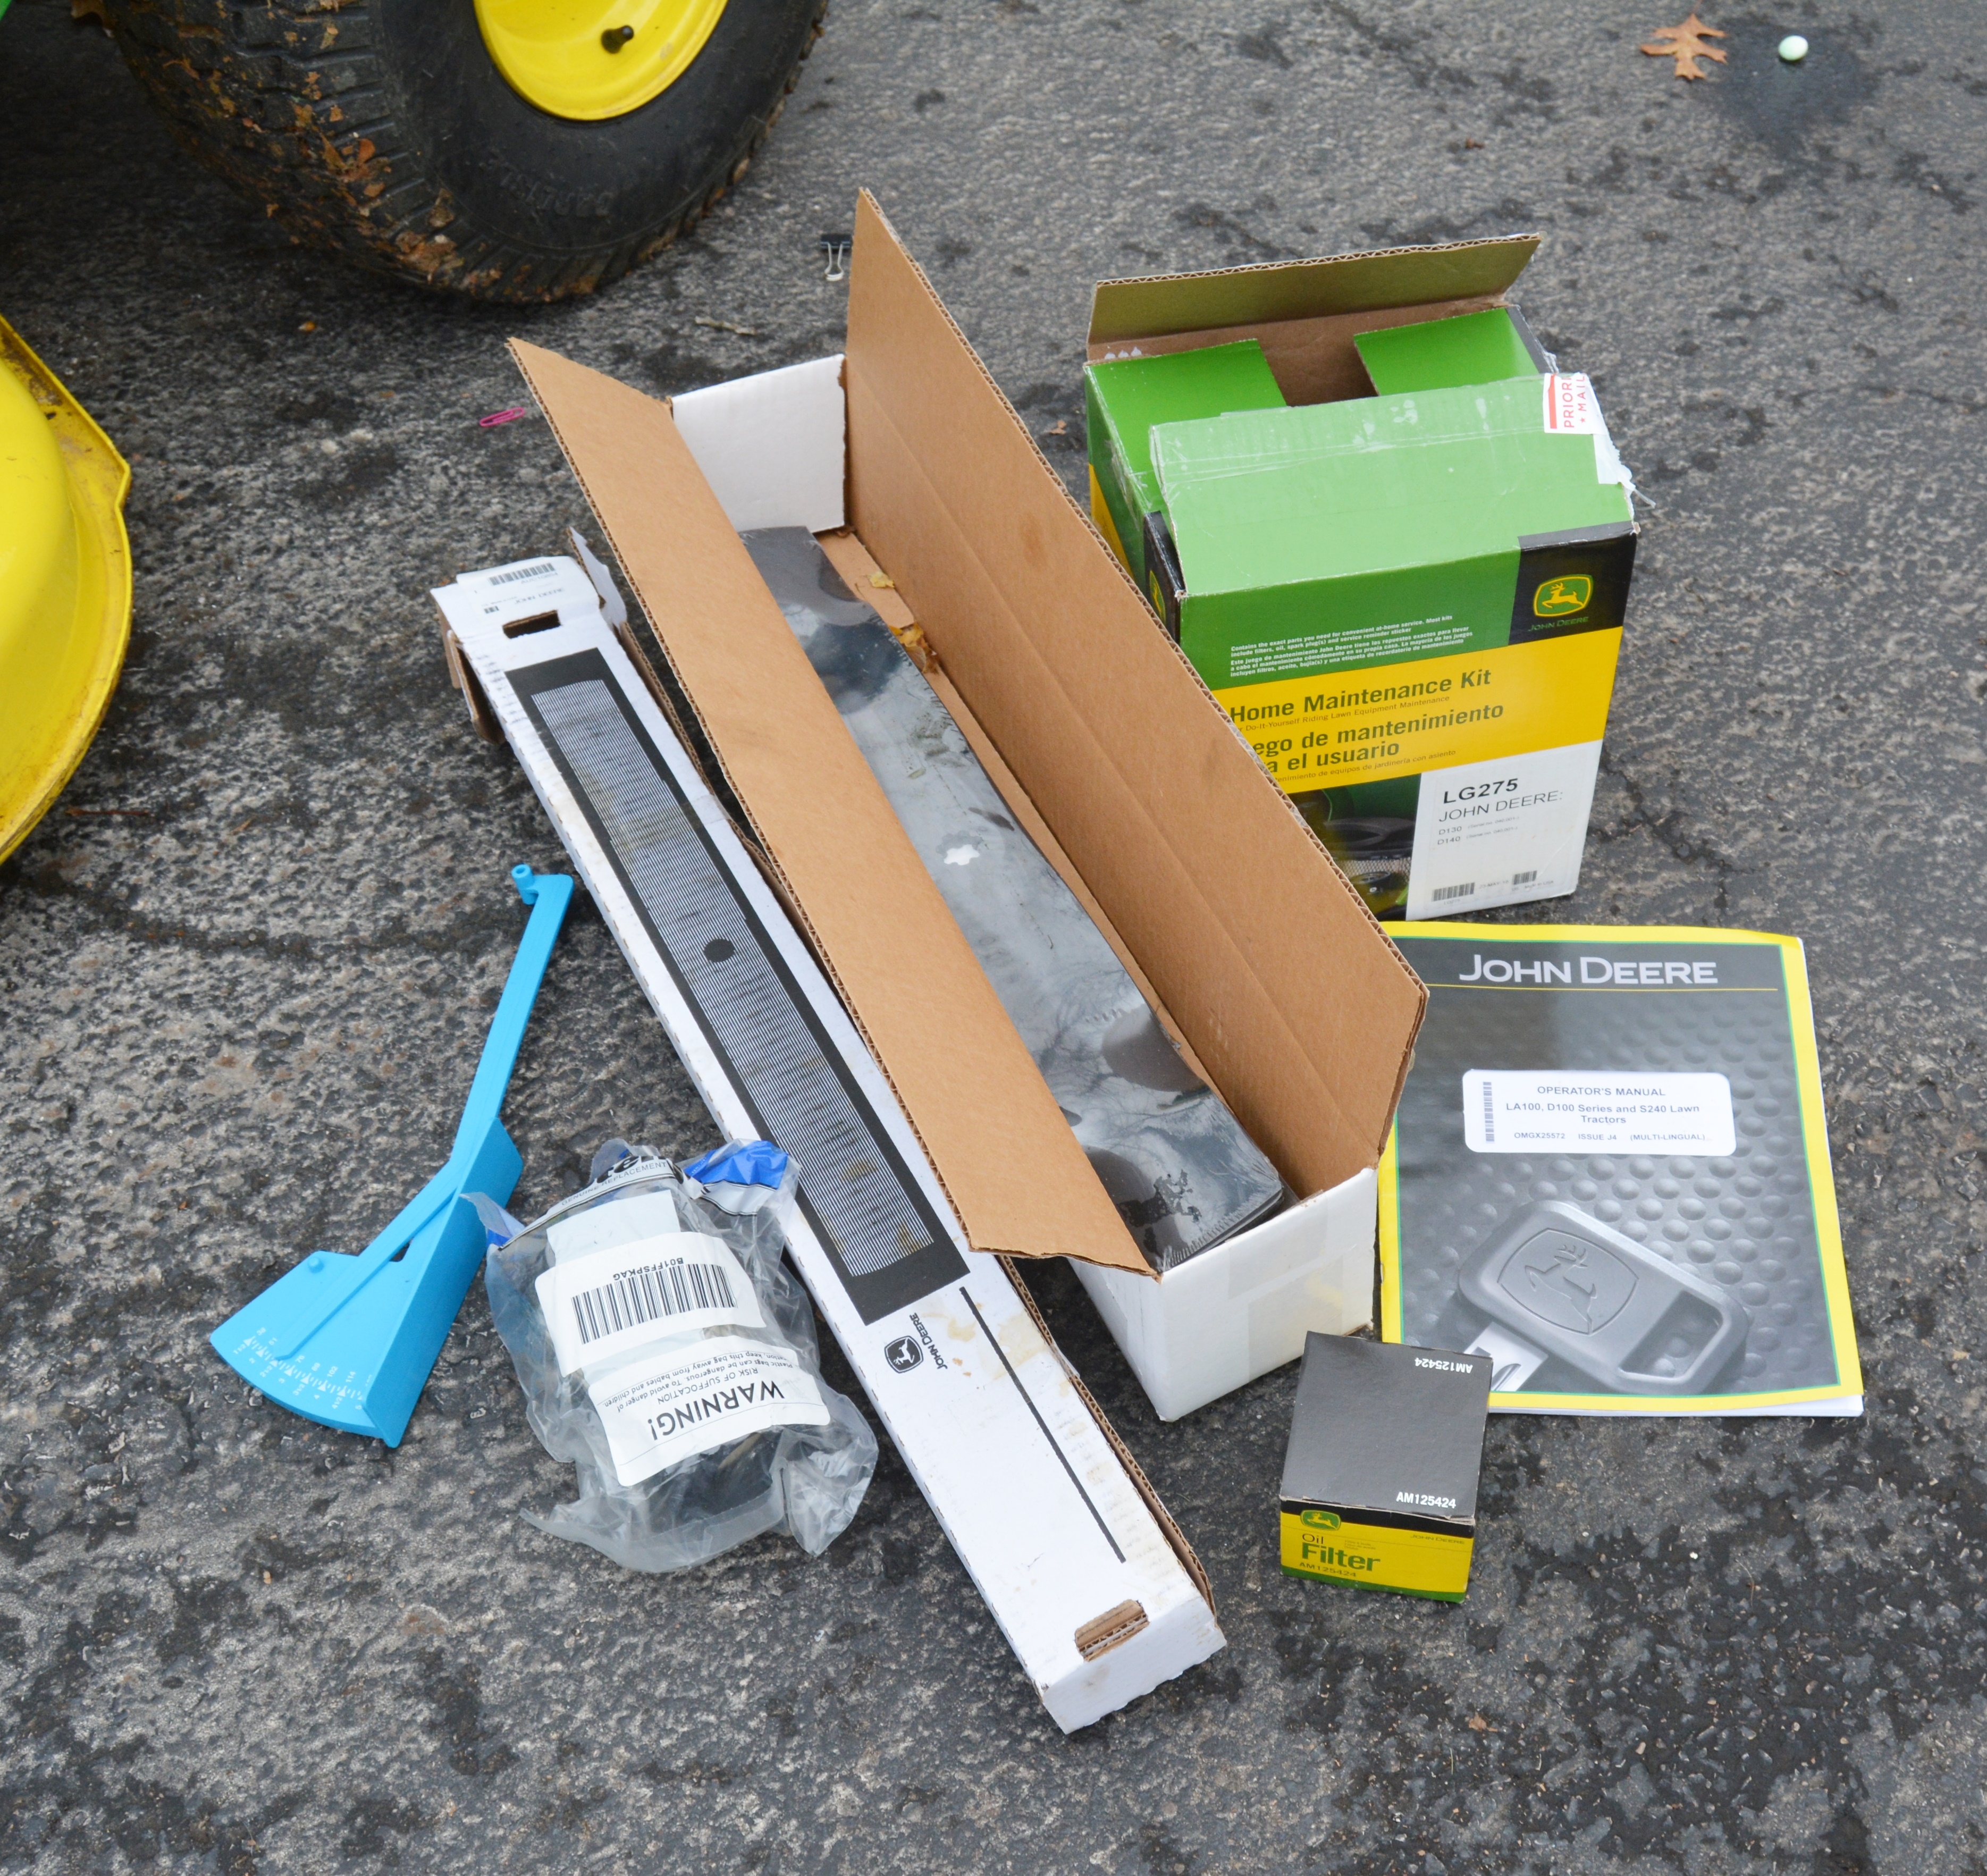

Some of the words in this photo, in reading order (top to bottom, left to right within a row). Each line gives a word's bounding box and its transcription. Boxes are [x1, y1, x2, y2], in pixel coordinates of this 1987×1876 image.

[1576, 376, 1587, 411] MAIL
[1561, 377, 1575, 428] PRIORI
[1342, 627, 1374, 636] convenient
[1376, 622, 1400, 631] at-home
[1528, 622, 1555, 632] JOHN
[1556, 616, 1589, 627] DEERE
[1274, 649, 1318, 660] mantenimiento
[1383, 635, 1411, 644] repuestos
[1306, 640, 1326, 648] plug(s)
[1363, 630, 1389, 639] reminder
[1260, 657, 1302, 667] mantenimiento
[1304, 651, 1345, 661] cómodamente
[1364, 645, 1383, 654] propia
[1410, 637, 1433, 646] mayoría
[1453, 630, 1472, 640] juegos
[1231, 669, 1256, 678] incluyen
[1300, 659, 1323, 668] bujía(s)
[1342, 653, 1365, 662] etiqueta
[1376, 646, 1411, 657] recordatorio
[1421, 639, 1463, 650] mantenimiento
[1230, 702, 1294, 722] Home
[1304, 678, 1452, 713] Maintenance
[1461, 669, 1491, 688] Kit
[1246, 718, 1300, 731] Do-It-Yourself
[1303, 713, 1328, 723] Riding
[1354, 704, 1396, 716] Equipment
[1400, 695, 1450, 708] Maintenance
[1253, 738, 1292, 758] ego
[1302, 732, 1328, 748] de
[1337, 705, 1503, 743] mantenimiento
[1287, 753, 1307, 770] el
[1317, 741, 1399, 766] usuario
[1330, 764, 1360, 775] equipos
[1374, 756, 1410, 769] jardinería
[1429, 750, 1455, 759] asiento
[1443, 778, 1519, 804] LG275
[1439, 804, 1489, 822] JOHN
[1495, 790, 1563, 812] DEERE:
[1438, 826, 1462, 835] D130
[1437, 836, 1461, 845] D140
[1459, 954, 1571, 983] JOHN
[1580, 957, 1718, 985] DEERE
[1537, 1086, 1611, 1096] OPERATOR'S
[1616, 1088, 1666, 1096] MANUAL
[1506, 1103, 1544, 1112] LA100,
[1547, 1103, 1575, 1112] D100
[1578, 1104, 1612, 1113] Series
[1580, 1115, 1626, 1124] Tractors
[562, 1185, 599, 1206] GENUINE
[602, 1162, 667, 1186] REPLACEMENT
[613, 1257, 684, 1281] B01FFSPKAG
[909, 1313, 932, 1345] DEERE
[692, 1360, 712, 1370] away
[713, 1356, 728, 1367] bag
[729, 1352, 743, 1361] this
[754, 1358, 769, 1367] bags
[928, 1344, 948, 1369] JOHN
[327, 1366, 339, 1377] 102
[672, 1367, 691, 1376] from
[684, 1365, 725, 1383] dangerous.
[738, 1368, 759, 1378] RISK
[1415, 1357, 1473, 1374] AM125424
[645, 1374, 670, 1387] babies
[671, 1379, 682, 1387] To
[723, 1372, 736, 1382] OF
[631, 1383, 644, 1394] and
[650, 1382, 670, 1395] avoid
[657, 1377, 721, 1405] SUFFOCATION
[602, 1389, 630, 1408] children.
[625, 1390, 649, 1407] danger
[616, 1403, 624, 1413] of
[648, 1381, 785, 1441] WARNING!
[1396, 1492, 1457, 1509] AM125424
[1302, 1533, 1324, 1545] Oil
[1302, 1542, 1381, 1572] Filter
[1299, 1562, 1357, 1577] AM125424
